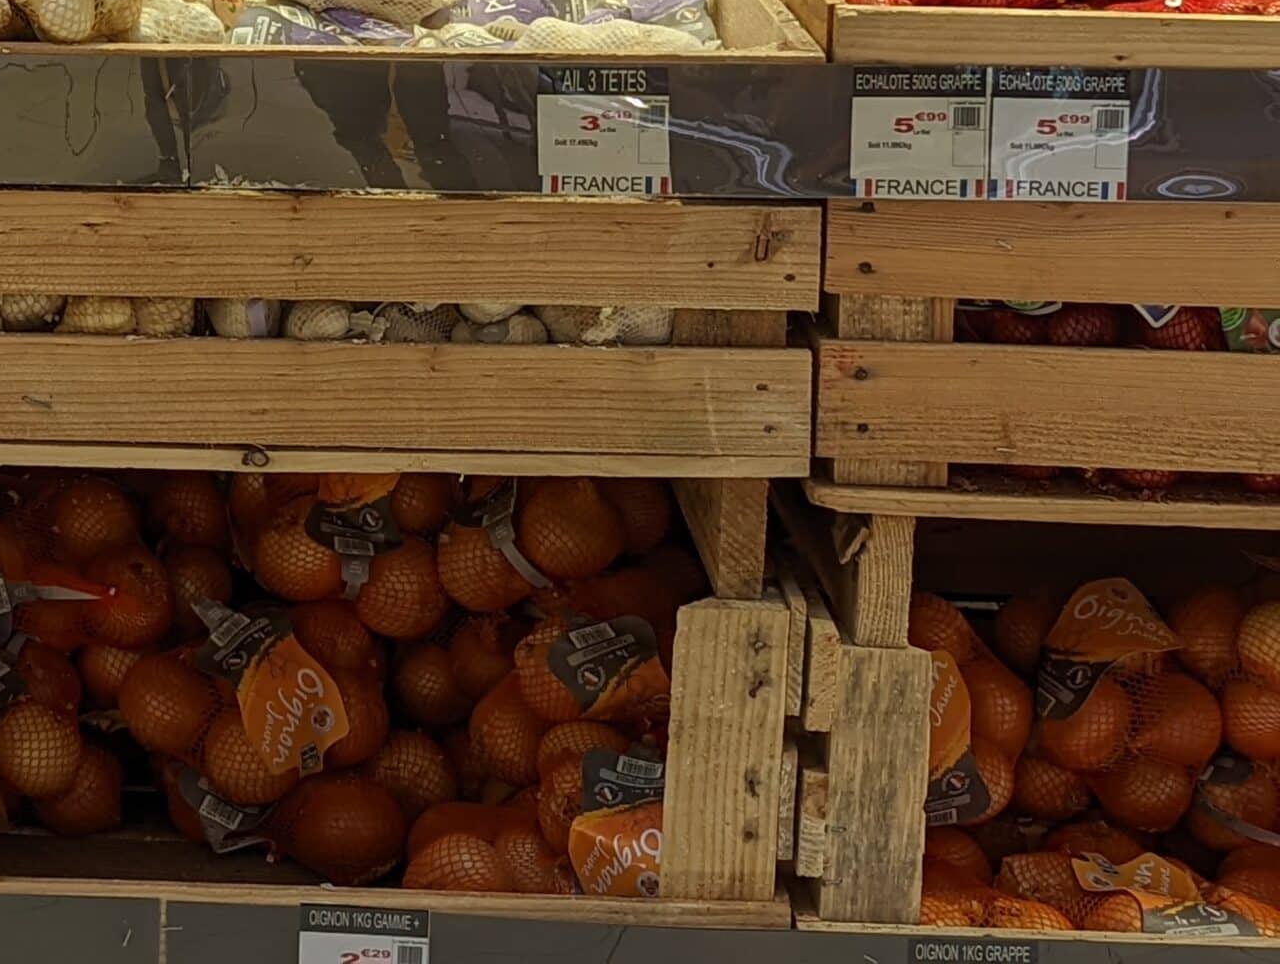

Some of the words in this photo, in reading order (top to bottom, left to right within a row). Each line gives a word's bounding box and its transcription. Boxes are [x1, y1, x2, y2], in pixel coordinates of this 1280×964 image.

[562, 69, 584, 92] AIL
[588, 69, 597, 92] 3
[600, 69, 647, 92] TETES
[856, 74, 910, 91] ECHALOTE
[911, 75, 937, 91] 500G
[939, 75, 982, 91] GRAPPE
[999, 74, 1053, 92] ECHALOTE
[1084, 76, 1126, 93] GRAPPE
[561, 176, 643, 192] FRANCE
[875, 179, 957, 196] FRANCE
[1017, 180, 1099, 198] FRANCE
[273, 667, 324, 764] Oignon
[591, 828, 663, 894] Oignon
[309, 910, 350, 927] OIGNON
[352, 912, 371, 929] 1KG
[373, 913, 411, 930] GAMME
[915, 943, 959, 961] OIGNON
[962, 944, 983, 961] 1KG
[985, 945, 1031, 963] GRAPPE
